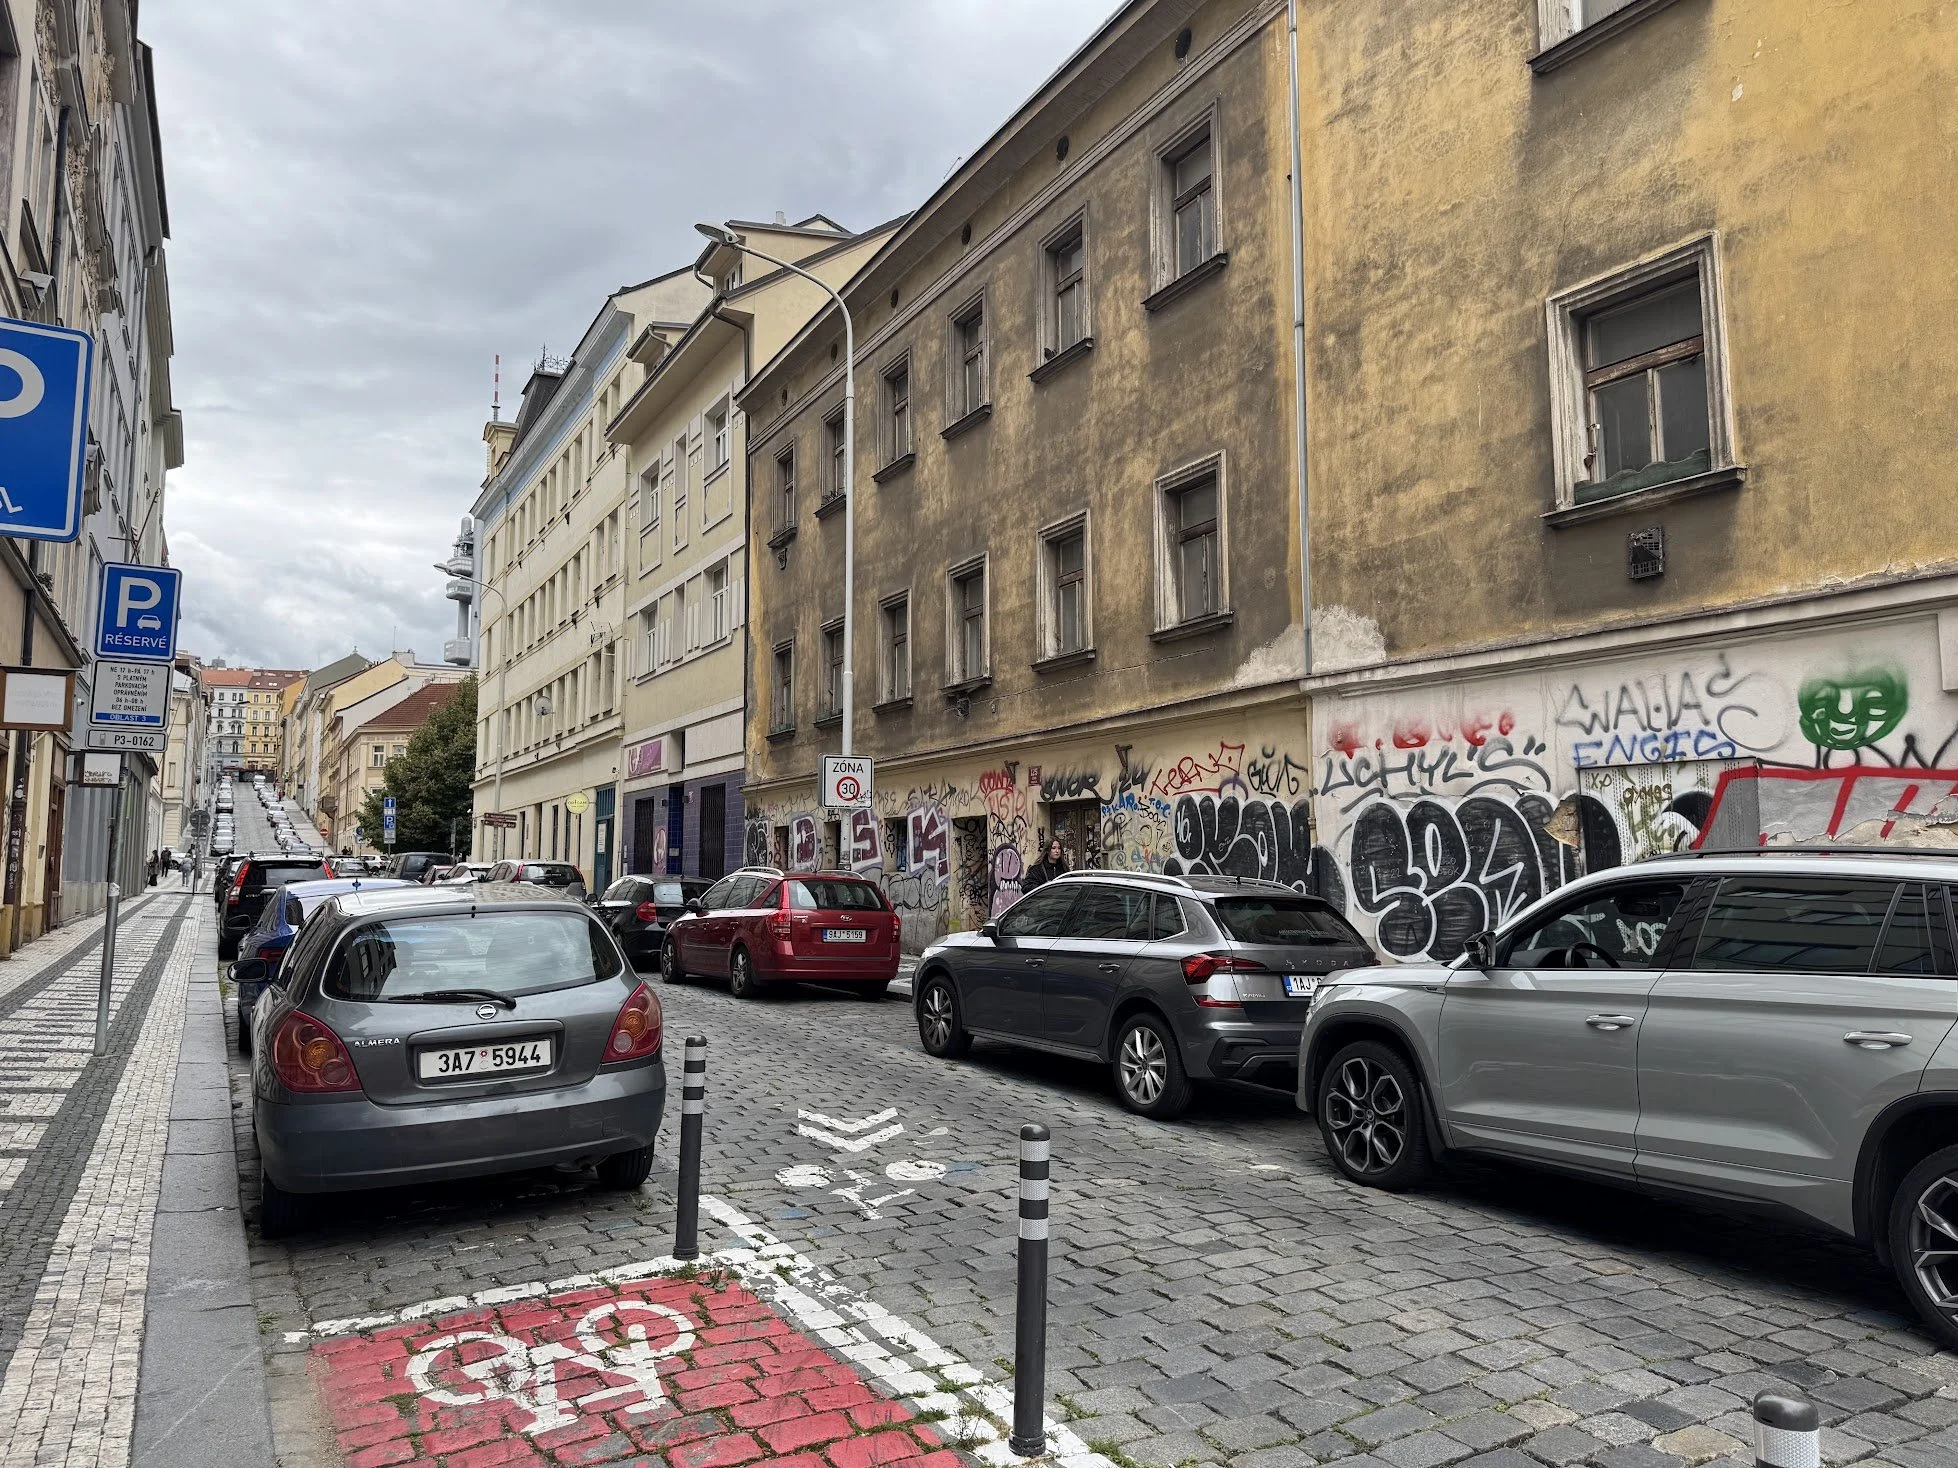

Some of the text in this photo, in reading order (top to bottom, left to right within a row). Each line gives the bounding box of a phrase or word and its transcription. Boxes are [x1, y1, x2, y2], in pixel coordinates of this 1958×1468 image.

[117, 576, 161, 627] P
[105, 632, 167, 648] RÉSERVÉ
[110, 713, 138, 721] OBLAST
[114, 735, 154, 746] P3-0162
[832, 760, 864, 773] ZÓNA
[842, 784, 856, 795] 30
[386, 816, 394, 825] P
[828, 930, 863, 938] 9AJ 5159
[1293, 977, 1312, 990] 1AJ
[354, 1038, 400, 1048] ALMERA
[438, 1044, 541, 1072] 3A7 5944
